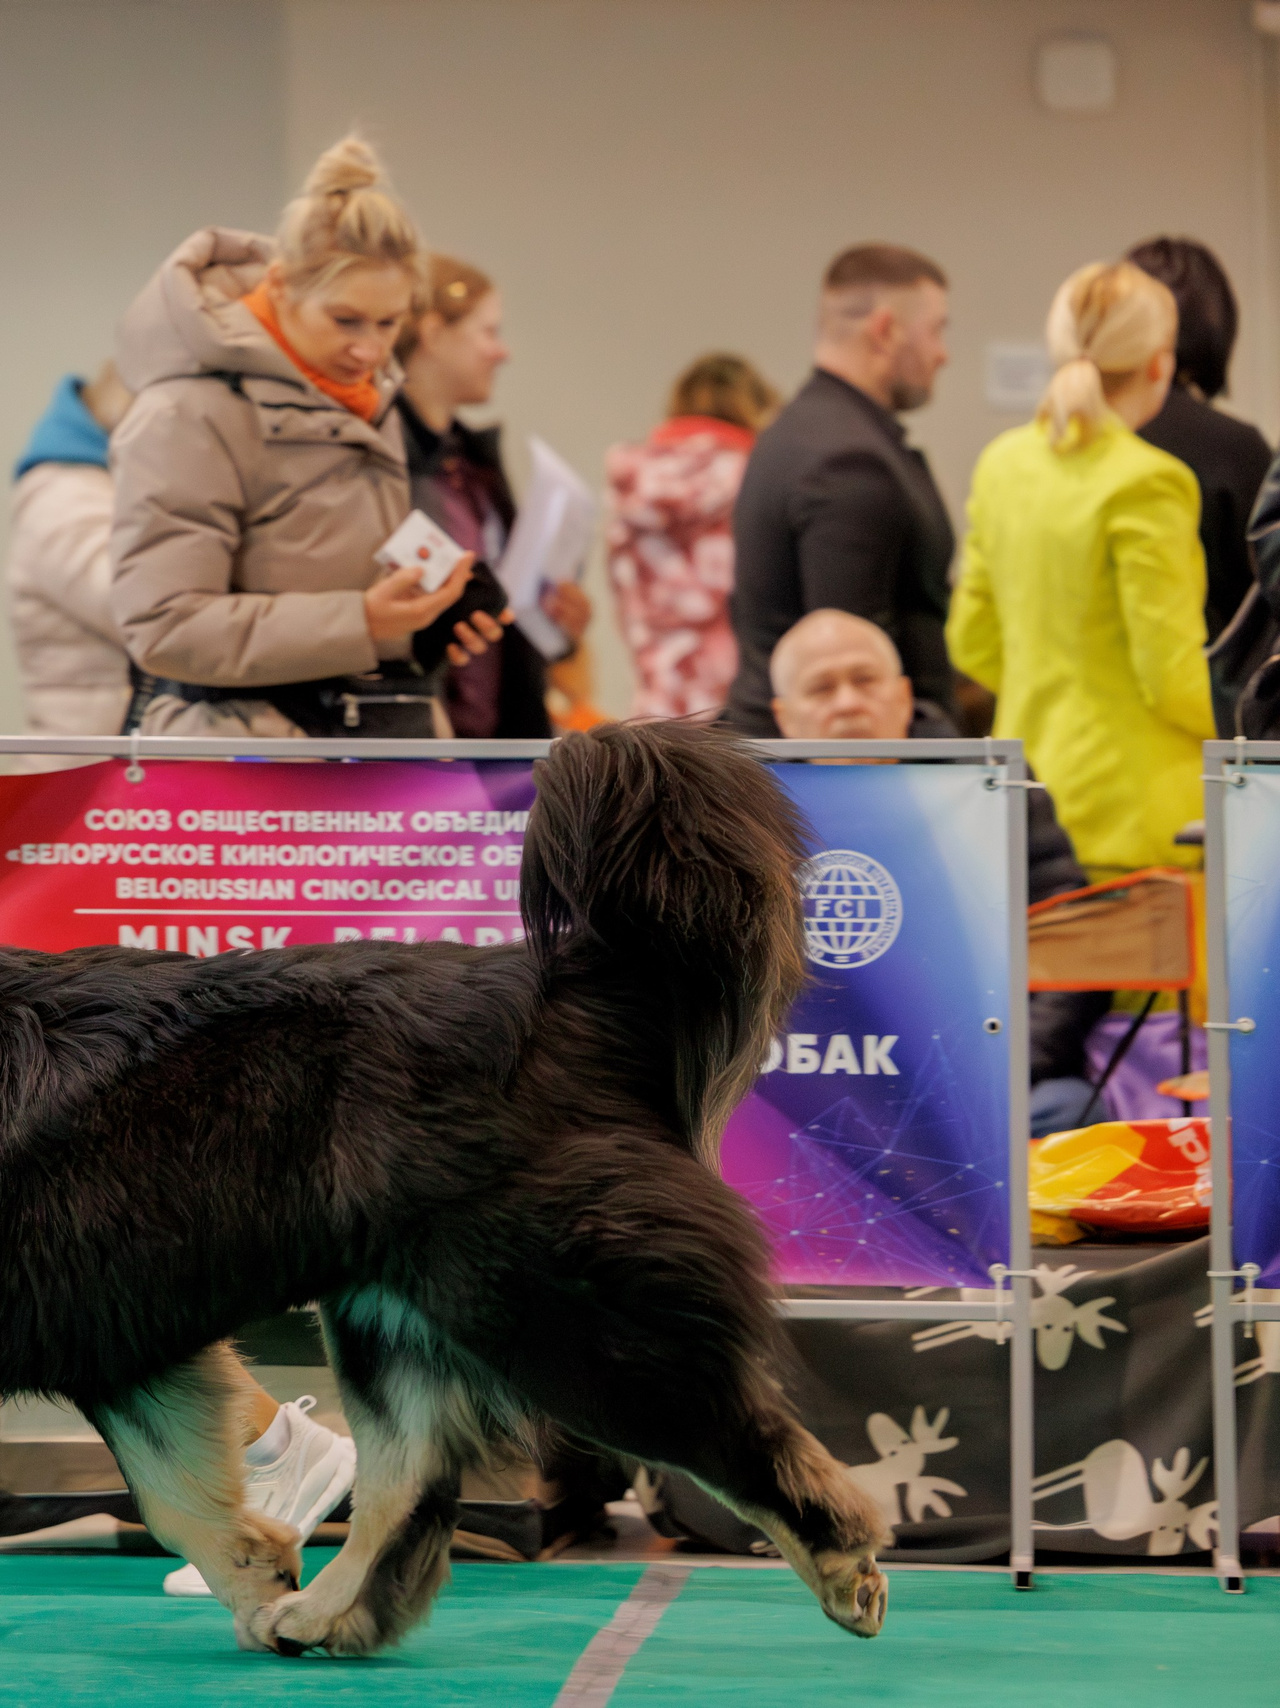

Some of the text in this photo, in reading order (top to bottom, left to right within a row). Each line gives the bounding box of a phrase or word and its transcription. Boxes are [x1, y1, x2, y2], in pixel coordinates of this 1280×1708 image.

[84, 809, 531, 836] СОЮЗ ОБЩЕСТВЕННЫХ ОБЪЕДИ
[221, 844, 475, 867] КИНОЛОГИЧЕСКОЕ
[116, 877, 294, 901] BELORUSSIAN
[301, 878, 488, 901] CINOLOGICAL
[815, 899, 866, 918] FCI
